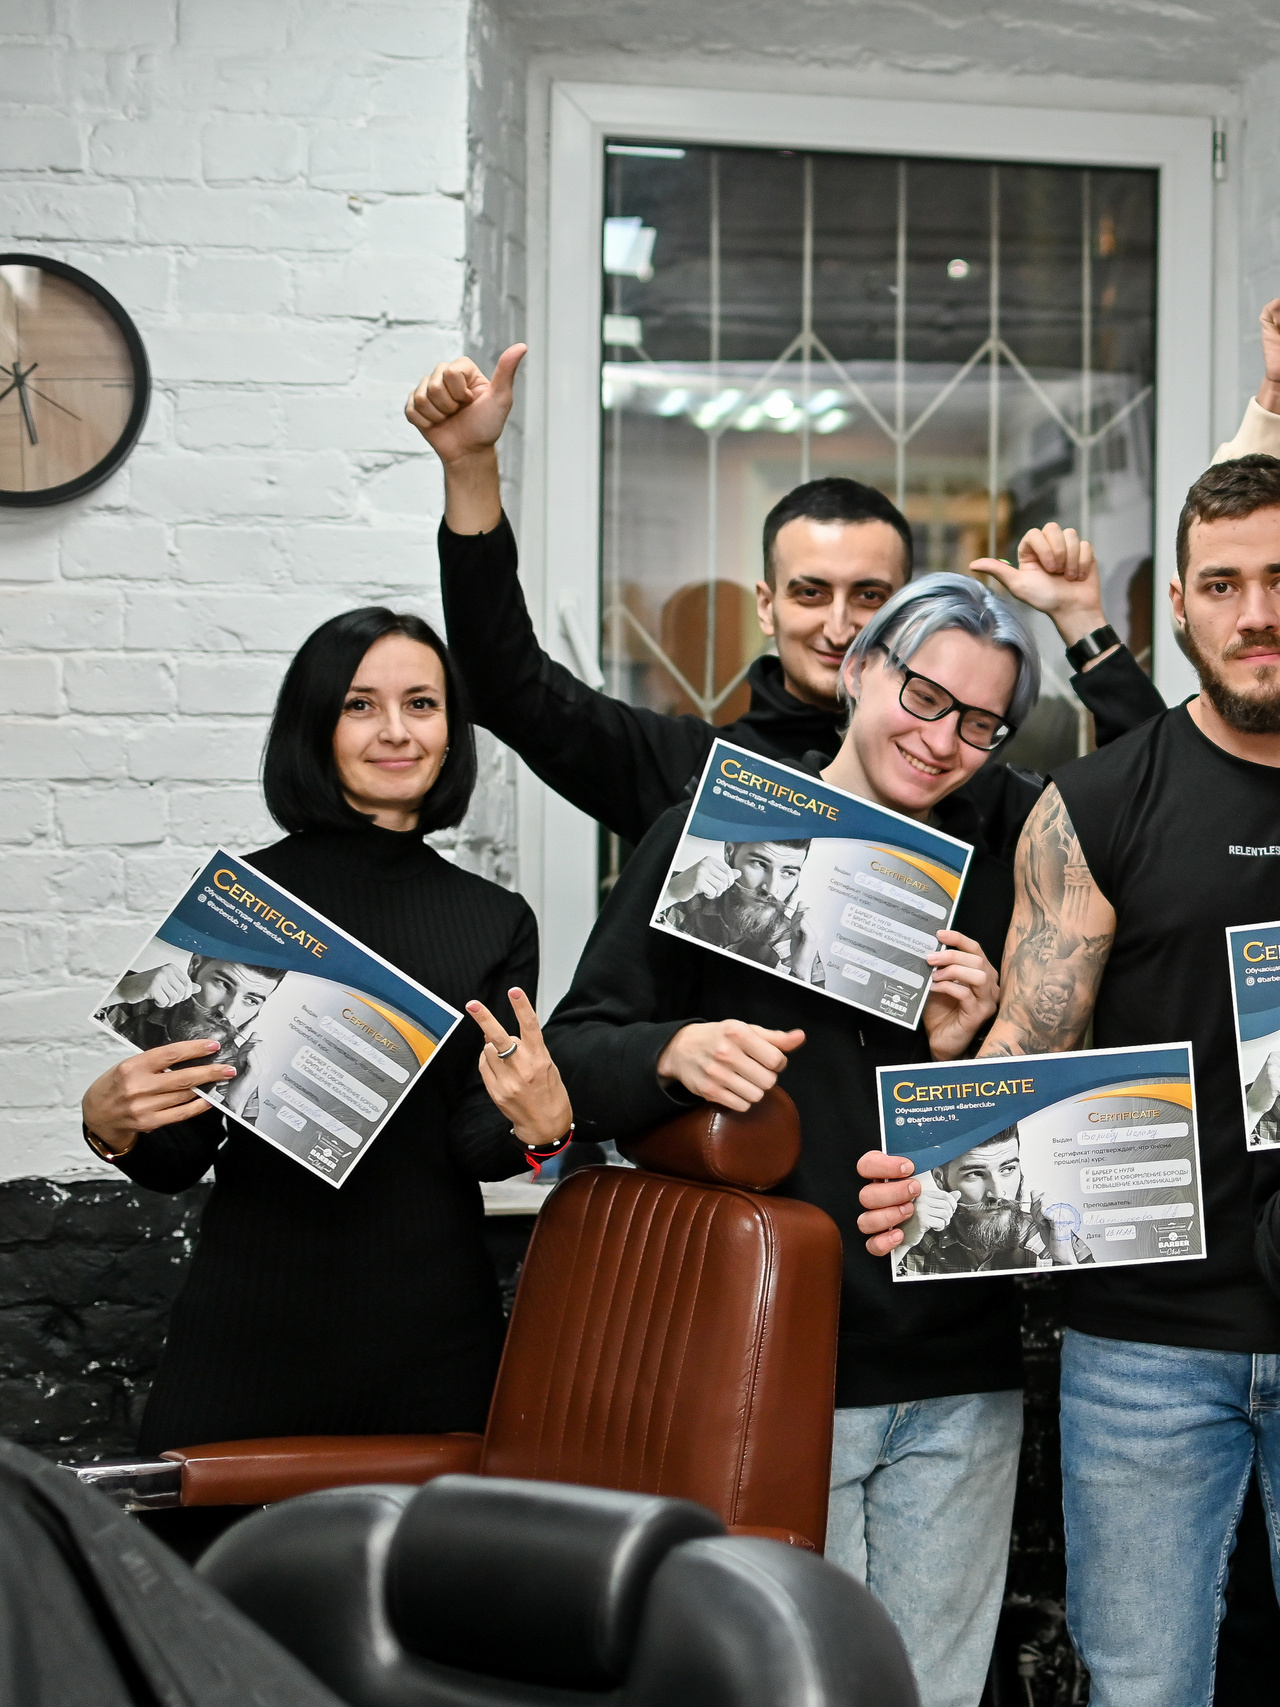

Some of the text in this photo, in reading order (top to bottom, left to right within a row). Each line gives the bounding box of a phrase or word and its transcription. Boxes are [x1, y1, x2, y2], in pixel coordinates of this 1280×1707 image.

[721, 759, 840, 822] CERTIFICATE
[214, 869, 328, 959] CERTIFICATE
[1245, 964, 1280, 973] Обучающая
[341, 1008, 399, 1053] CERTIFICATE
[893, 1077, 1035, 1102] CERTIFICATE
[1087, 1109, 1160, 1122] CERTIFICATE
[1158, 1239, 1189, 1248] BARBER
